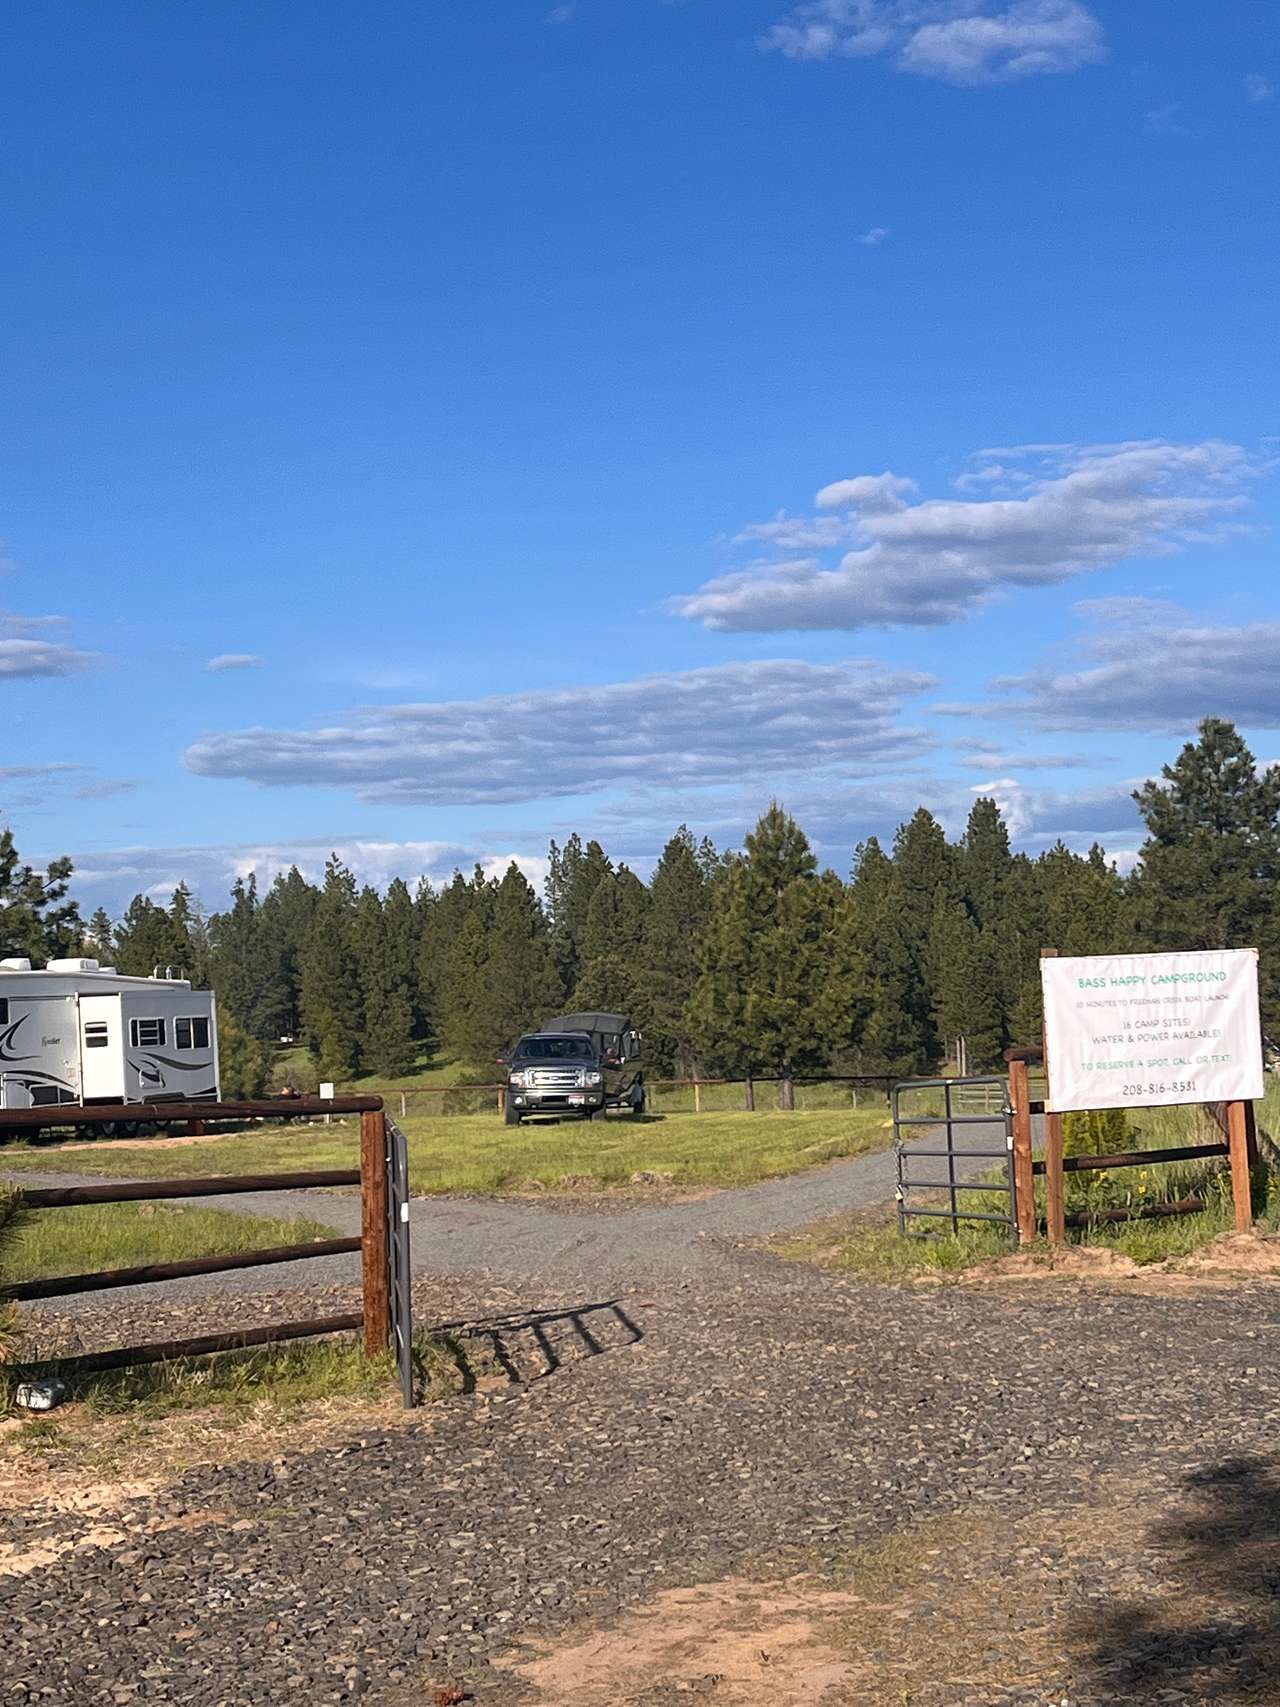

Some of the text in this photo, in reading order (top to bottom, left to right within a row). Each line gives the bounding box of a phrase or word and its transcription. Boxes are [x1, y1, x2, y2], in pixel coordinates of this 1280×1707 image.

[1078, 972, 1227, 988] BASS HAPPY CAMPGROUND
[1134, 1019, 1160, 1029] CAMP
[1092, 1034, 1124, 1044] WATER
[1128, 1034, 1134, 1043] &
[1137, 1032, 1170, 1042] POWER
[1081, 1063, 1093, 1071] TO
[1096, 1060, 1135, 1070] RESERVE
[1172, 1056, 1192, 1066] CALL
[1196, 1055, 1208, 1064] OR
[1122, 1080, 1196, 1096] 208-816-8531
